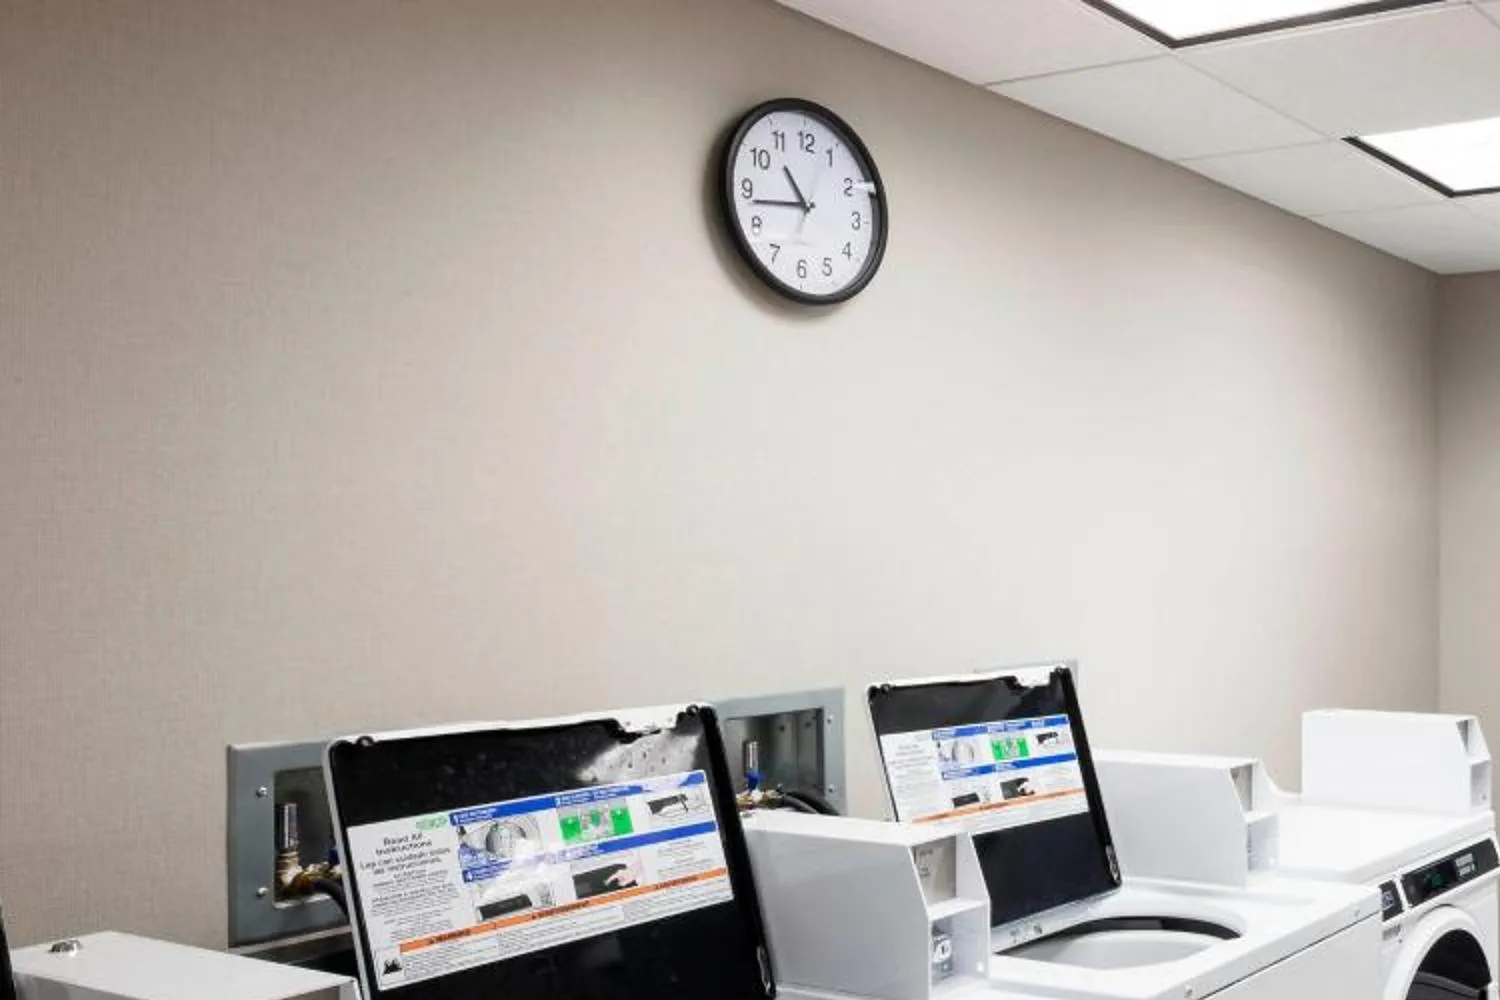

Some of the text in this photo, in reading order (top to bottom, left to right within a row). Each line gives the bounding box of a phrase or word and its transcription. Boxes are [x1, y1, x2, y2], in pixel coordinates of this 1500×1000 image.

[771, 130, 786, 152] 11
[798, 130, 816, 154] 12
[750, 147, 771, 170] 10
[826, 148, 834, 168] 1
[741, 178, 753, 199] 9
[843, 177, 854, 197] 2
[751, 215, 763, 237] 8
[851, 211, 861, 231] 3
[769, 243, 781, 263] 7
[841, 241, 853, 260] 4
[796, 259, 808, 279] 6
[821, 257, 833, 277] 5
